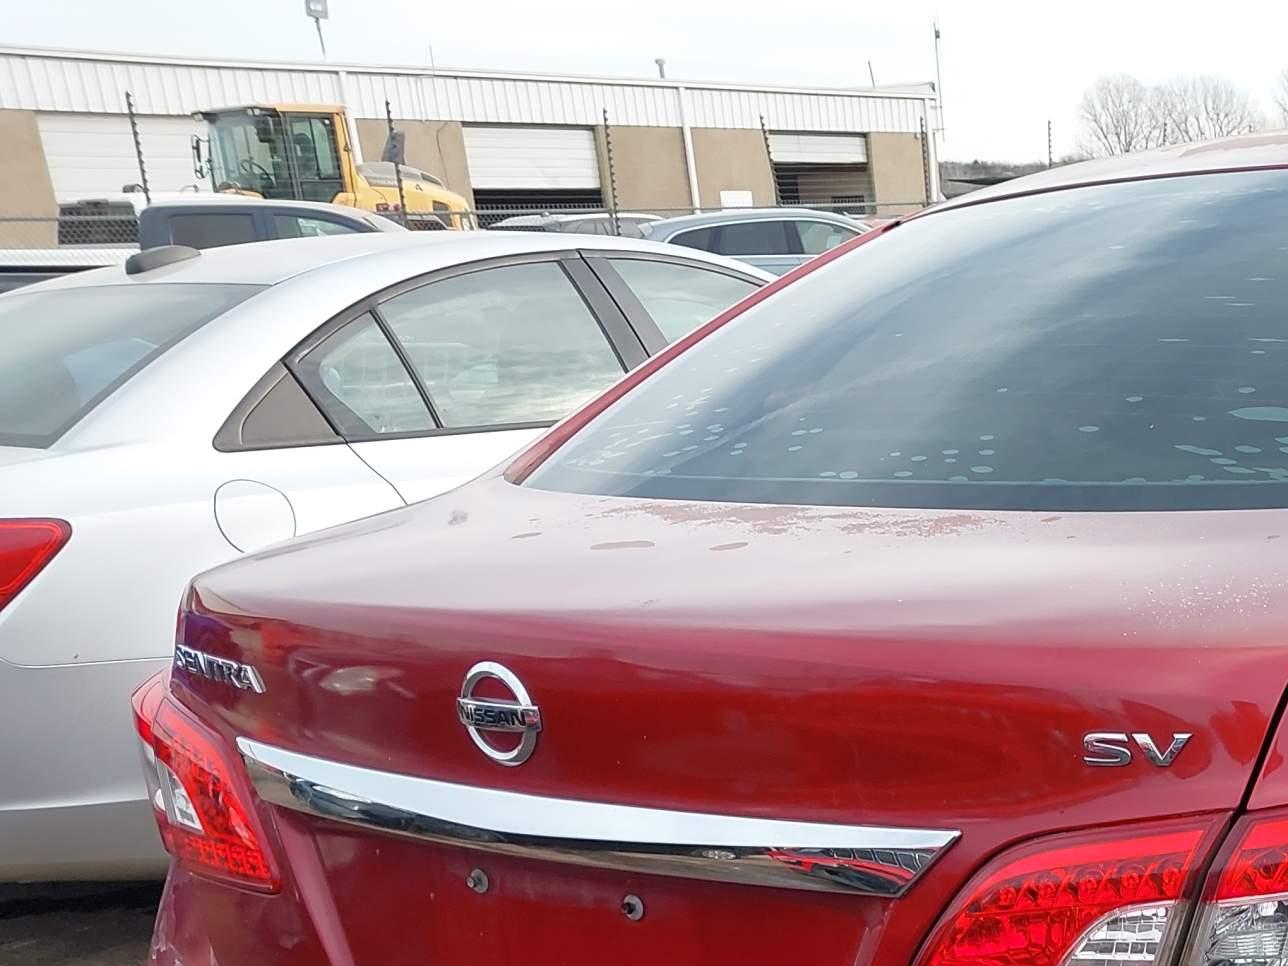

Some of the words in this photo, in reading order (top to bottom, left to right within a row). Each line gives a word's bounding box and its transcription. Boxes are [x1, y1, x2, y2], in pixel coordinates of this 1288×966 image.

[175, 644, 267, 694] SENTRA
[460, 704, 528, 728] NISSAN
[1083, 732, 1194, 767] SV
